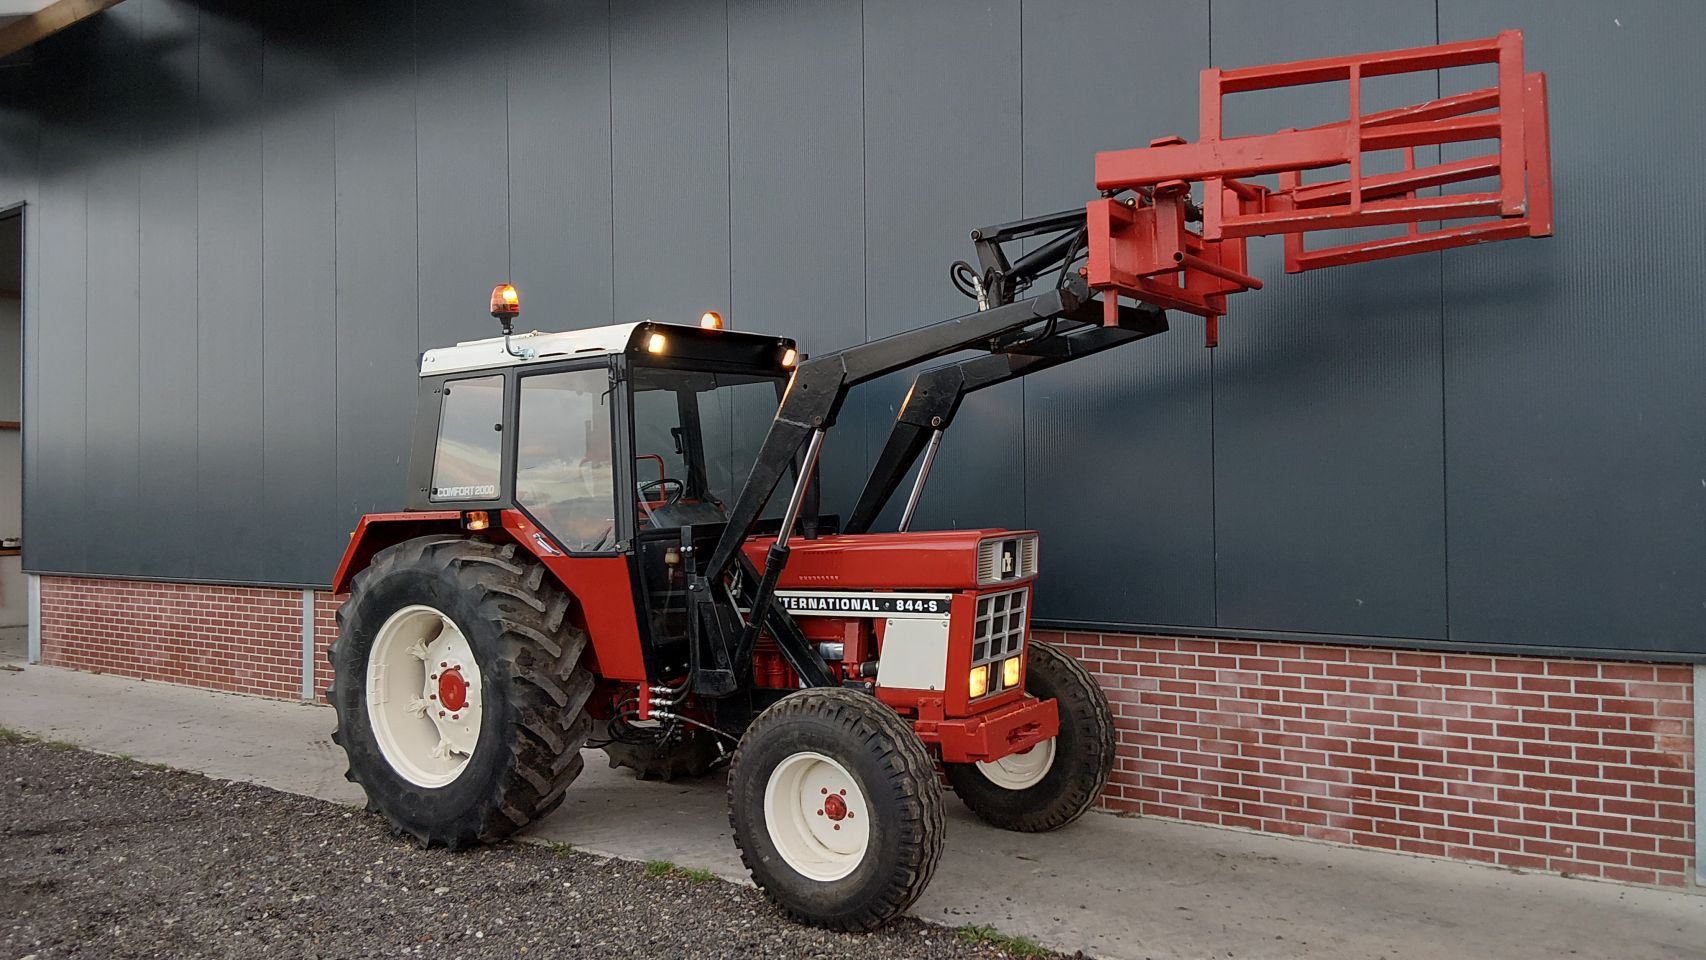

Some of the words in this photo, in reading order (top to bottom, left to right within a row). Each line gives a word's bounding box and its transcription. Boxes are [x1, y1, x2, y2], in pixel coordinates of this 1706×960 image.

[437, 486, 474, 497] COMFORT
[475, 485, 495, 495] 2000
[778, 597, 880, 611] TERNATIONAL
[896, 599, 938, 612] 844-S
